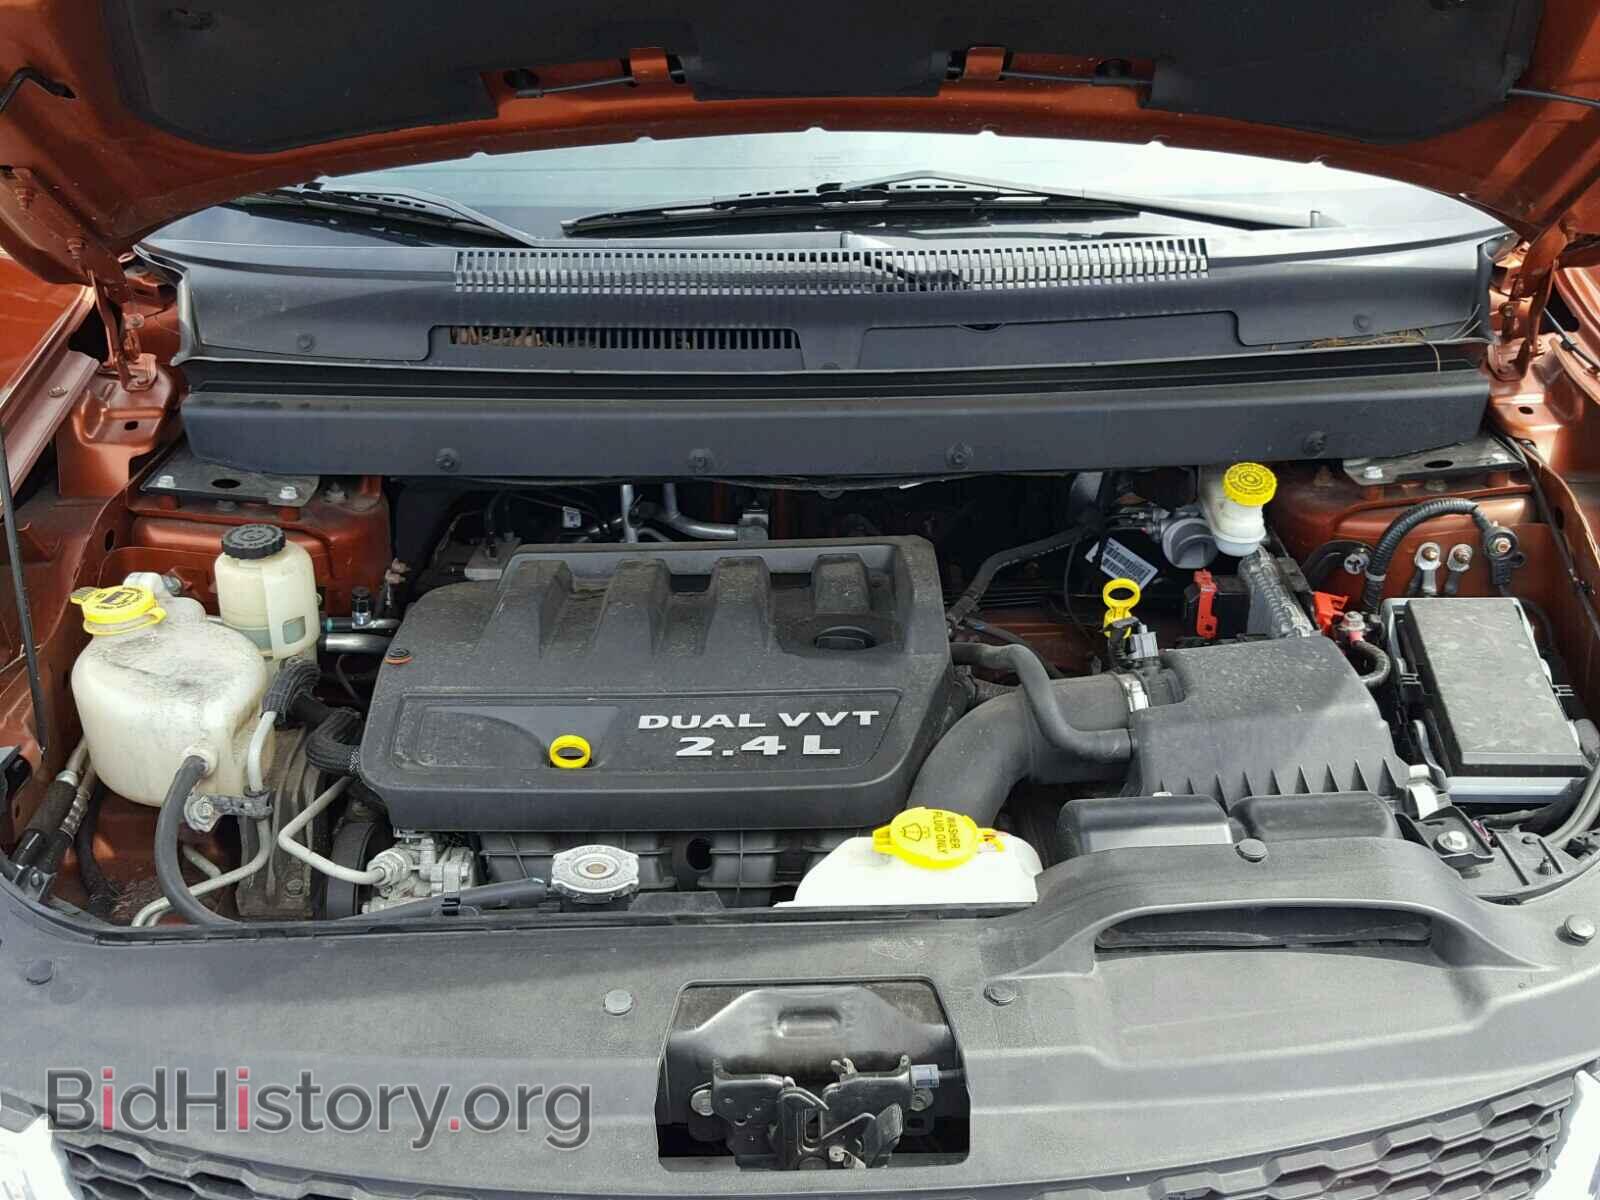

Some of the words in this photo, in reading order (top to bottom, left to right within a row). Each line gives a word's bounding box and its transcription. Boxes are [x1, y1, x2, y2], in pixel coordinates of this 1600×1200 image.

[638, 713, 766, 729] DUAL
[778, 710, 880, 727] VVT
[932, 811, 945, 832] FLUID
[946, 816, 961, 849] WASHER
[935, 834, 949, 855] ONLY
